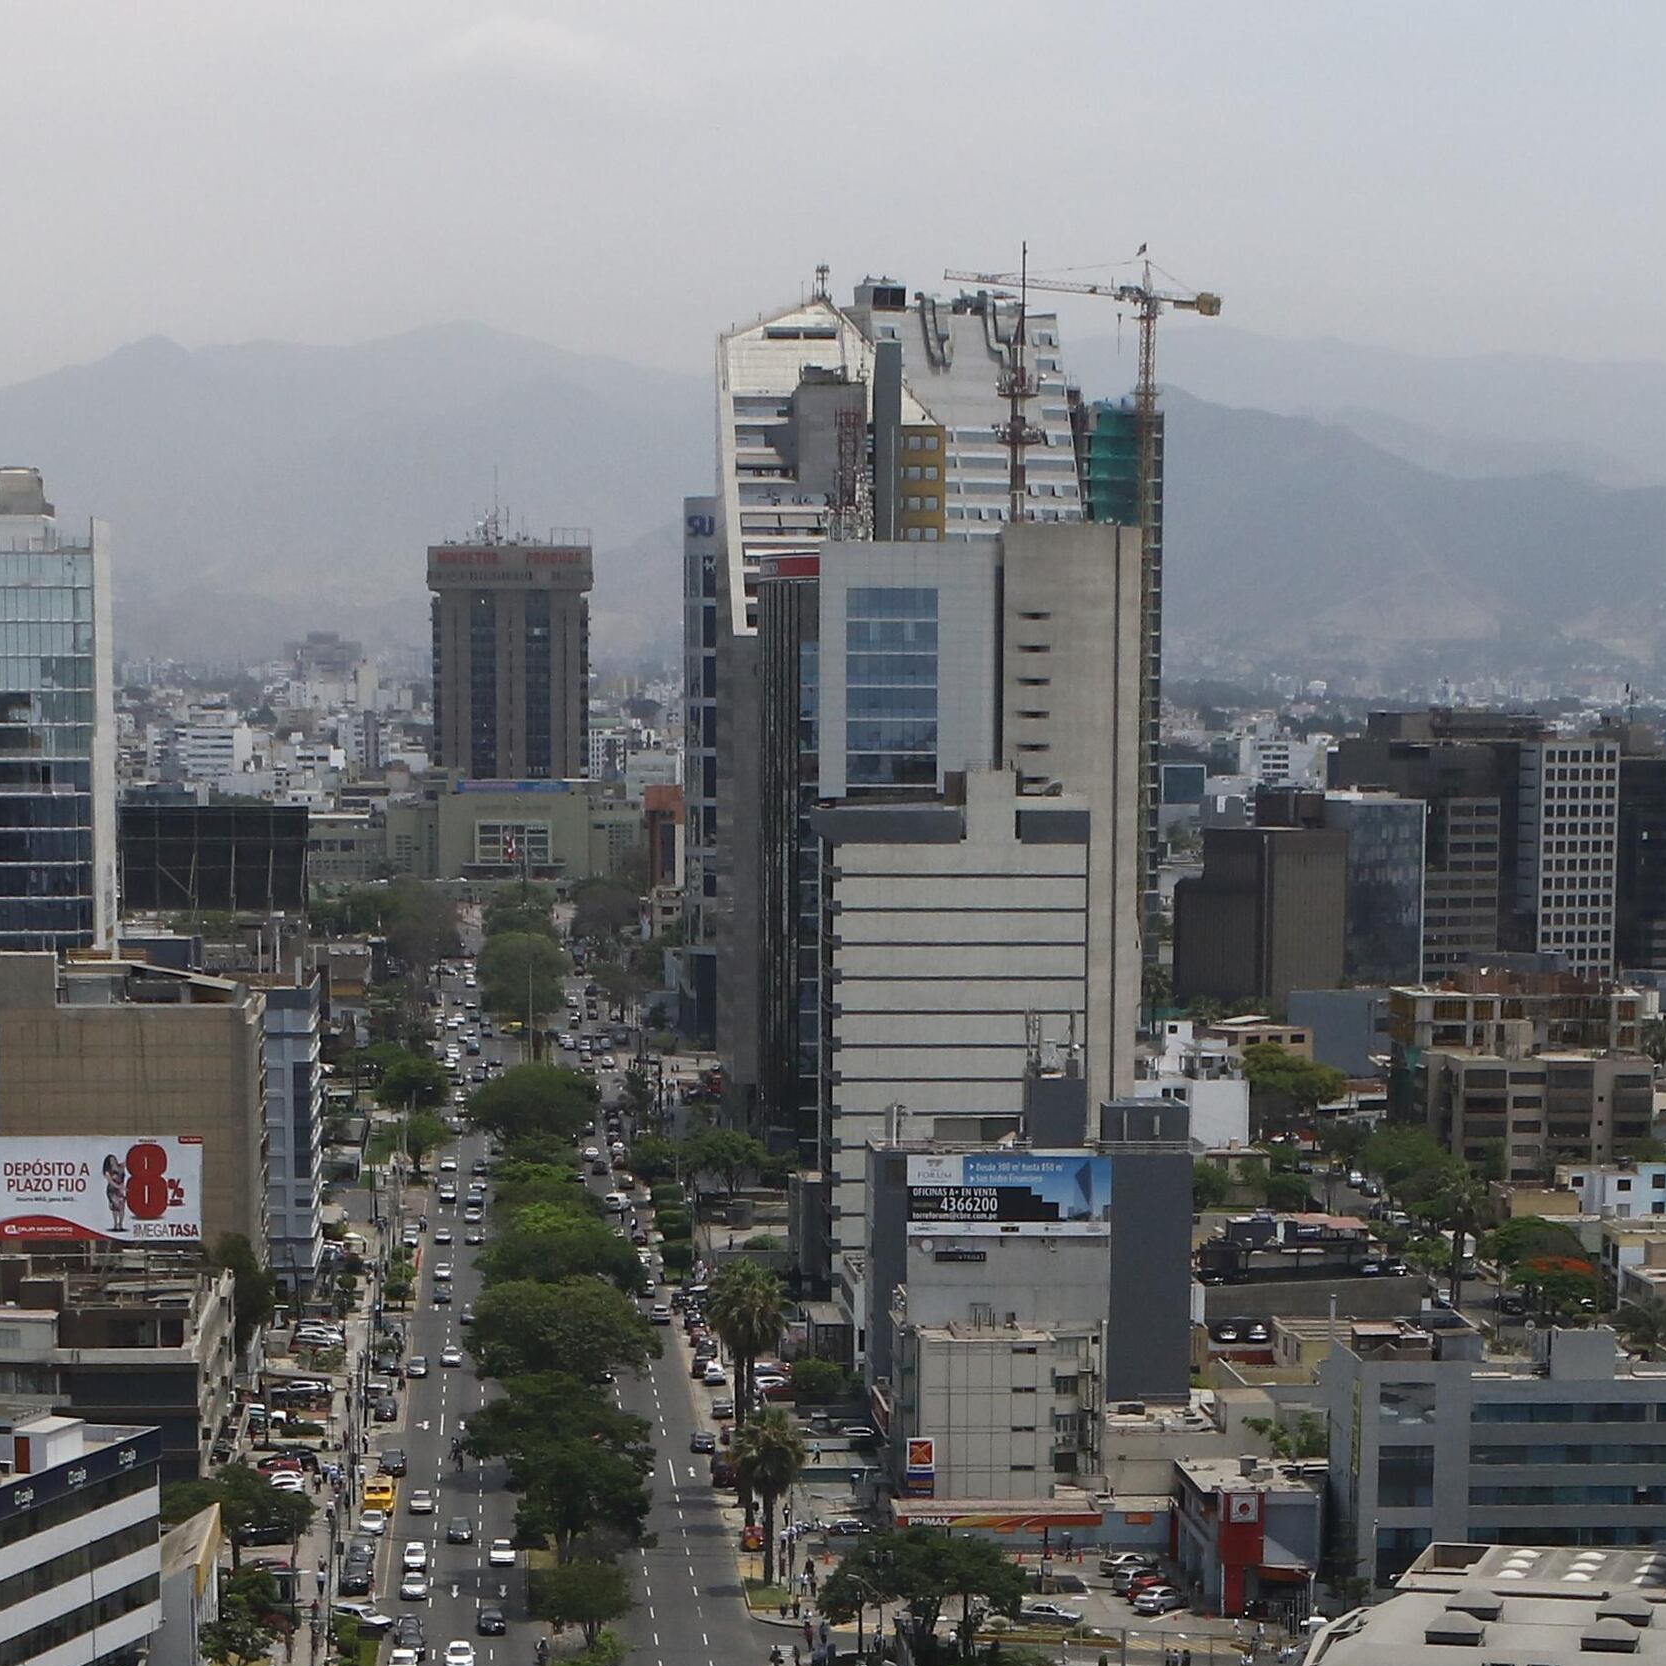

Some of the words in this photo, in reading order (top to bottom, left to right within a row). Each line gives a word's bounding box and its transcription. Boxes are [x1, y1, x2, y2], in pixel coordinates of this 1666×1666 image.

[4, 1159, 75, 1177] DEPÓSITO
[79, 1163, 90, 1176] A
[7, 1178, 53, 1193] PLAZO
[57, 1179, 87, 1193] FIJO
[913, 1187, 949, 1197] OFICINAS
[961, 1187, 972, 1197] EN
[973, 1187, 998, 1197] VENTA
[940, 1197, 998, 1212] 4366200
